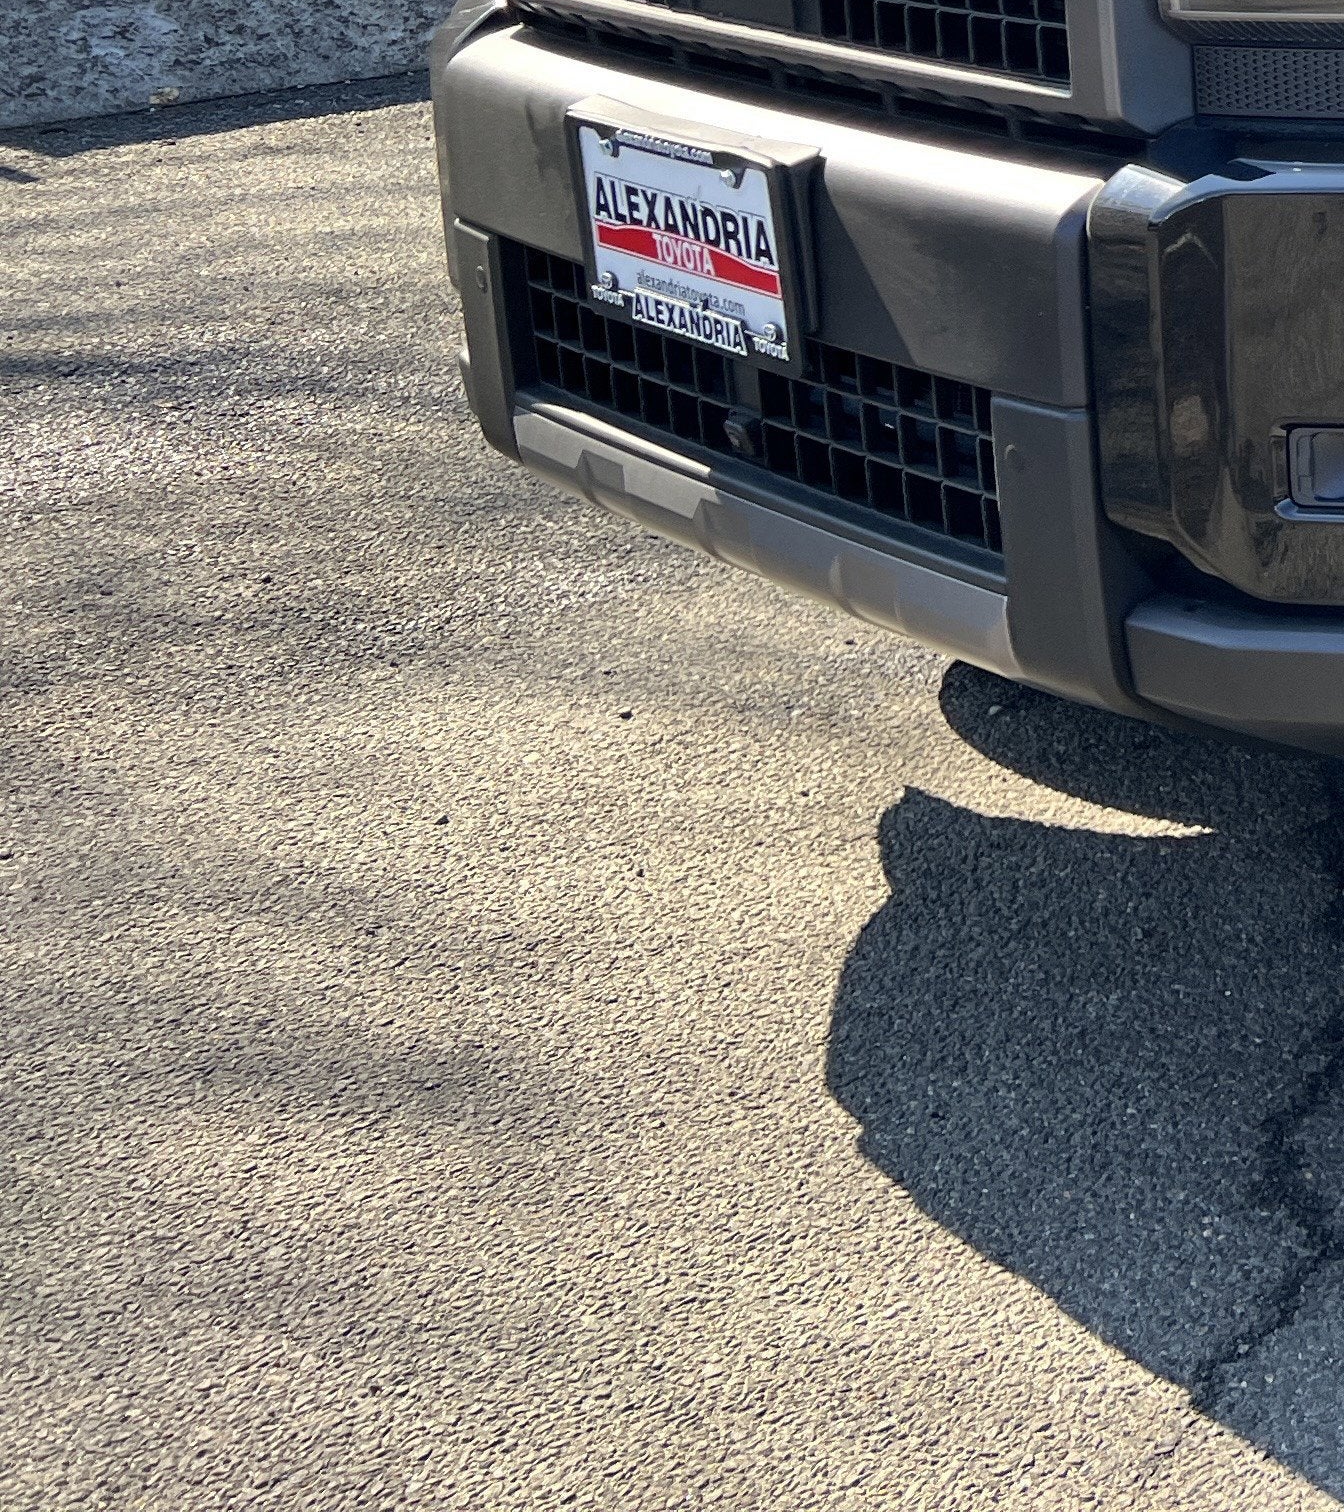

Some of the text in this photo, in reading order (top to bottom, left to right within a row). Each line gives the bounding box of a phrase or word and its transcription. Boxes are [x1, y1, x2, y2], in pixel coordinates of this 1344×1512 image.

[594, 176, 776, 267] ALEXANDRIA
[652, 233, 717, 277] TOYOTA
[591, 285, 625, 308] TOYOTA
[635, 267, 747, 317] alexandriatoyota.com
[633, 292, 748, 356] ALEXANDRIA
[752, 336, 790, 362] TOYOTA
